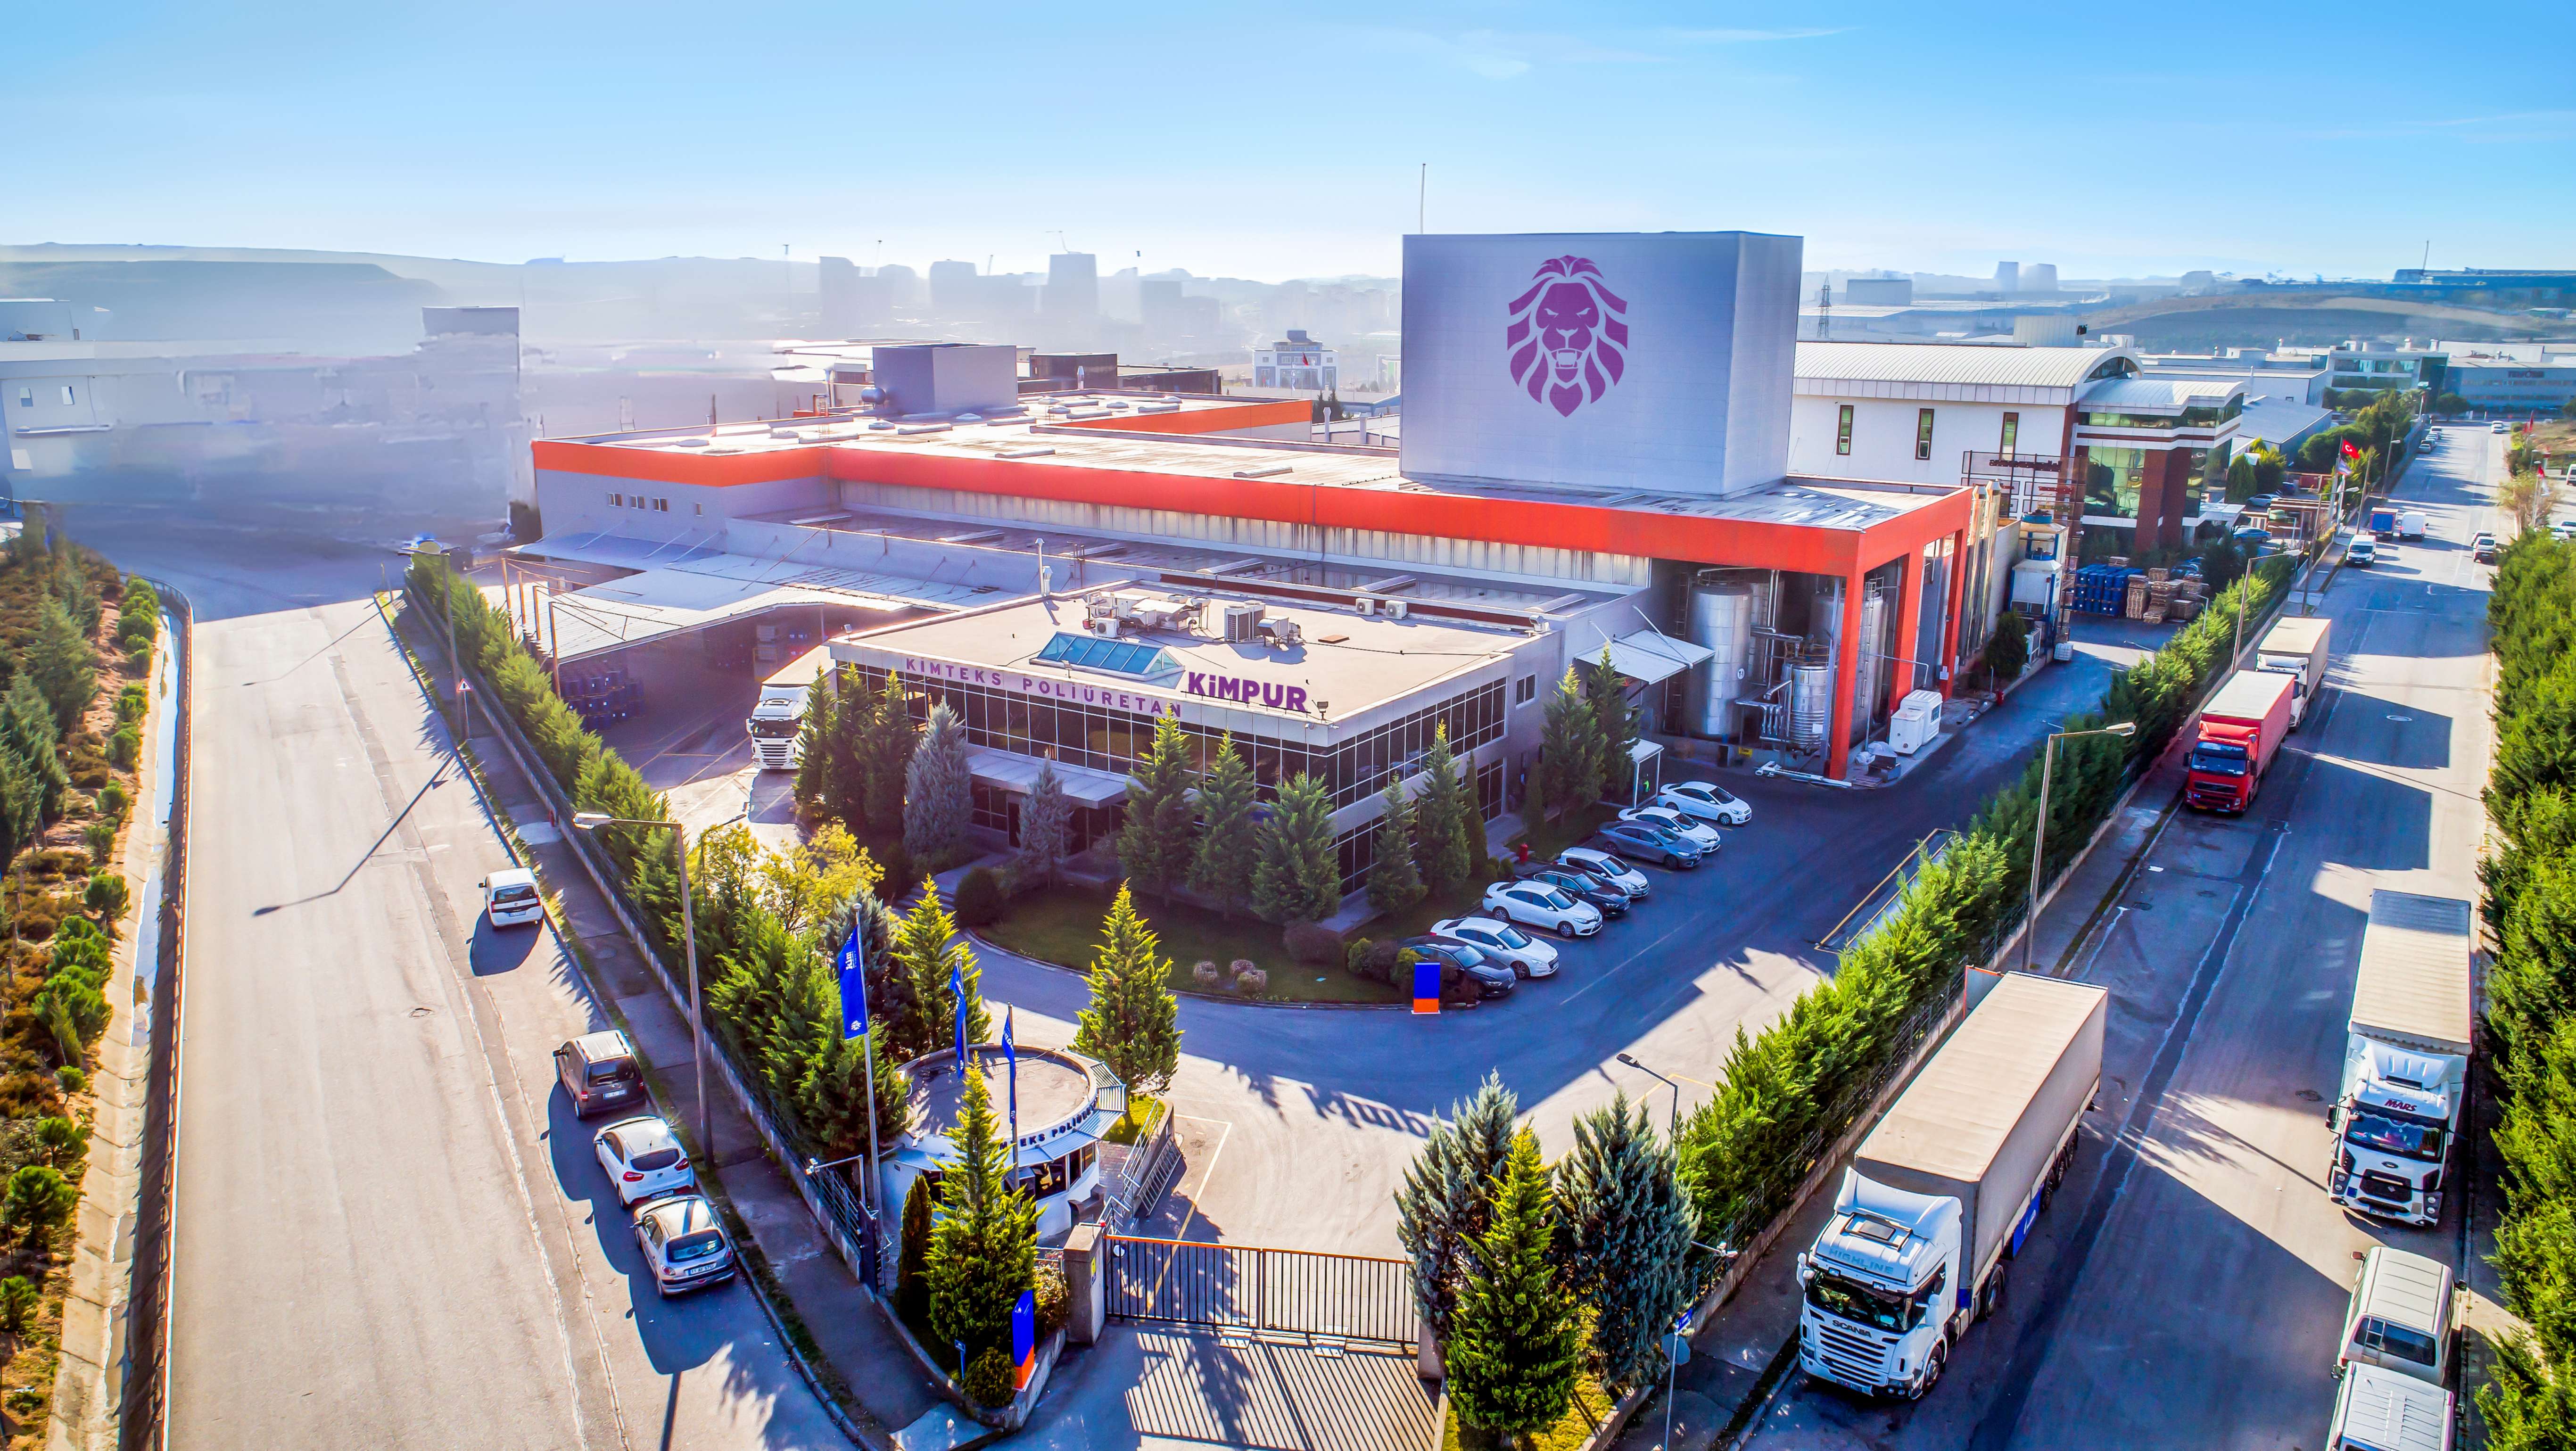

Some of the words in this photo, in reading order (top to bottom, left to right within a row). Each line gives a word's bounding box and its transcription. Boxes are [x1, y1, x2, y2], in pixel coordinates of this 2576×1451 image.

[2384, 1099, 2417, 1111] MARS
[1829, 1249, 1894, 1274] HIGHLINE
[1833, 1319, 1872, 1338] SCANIA
